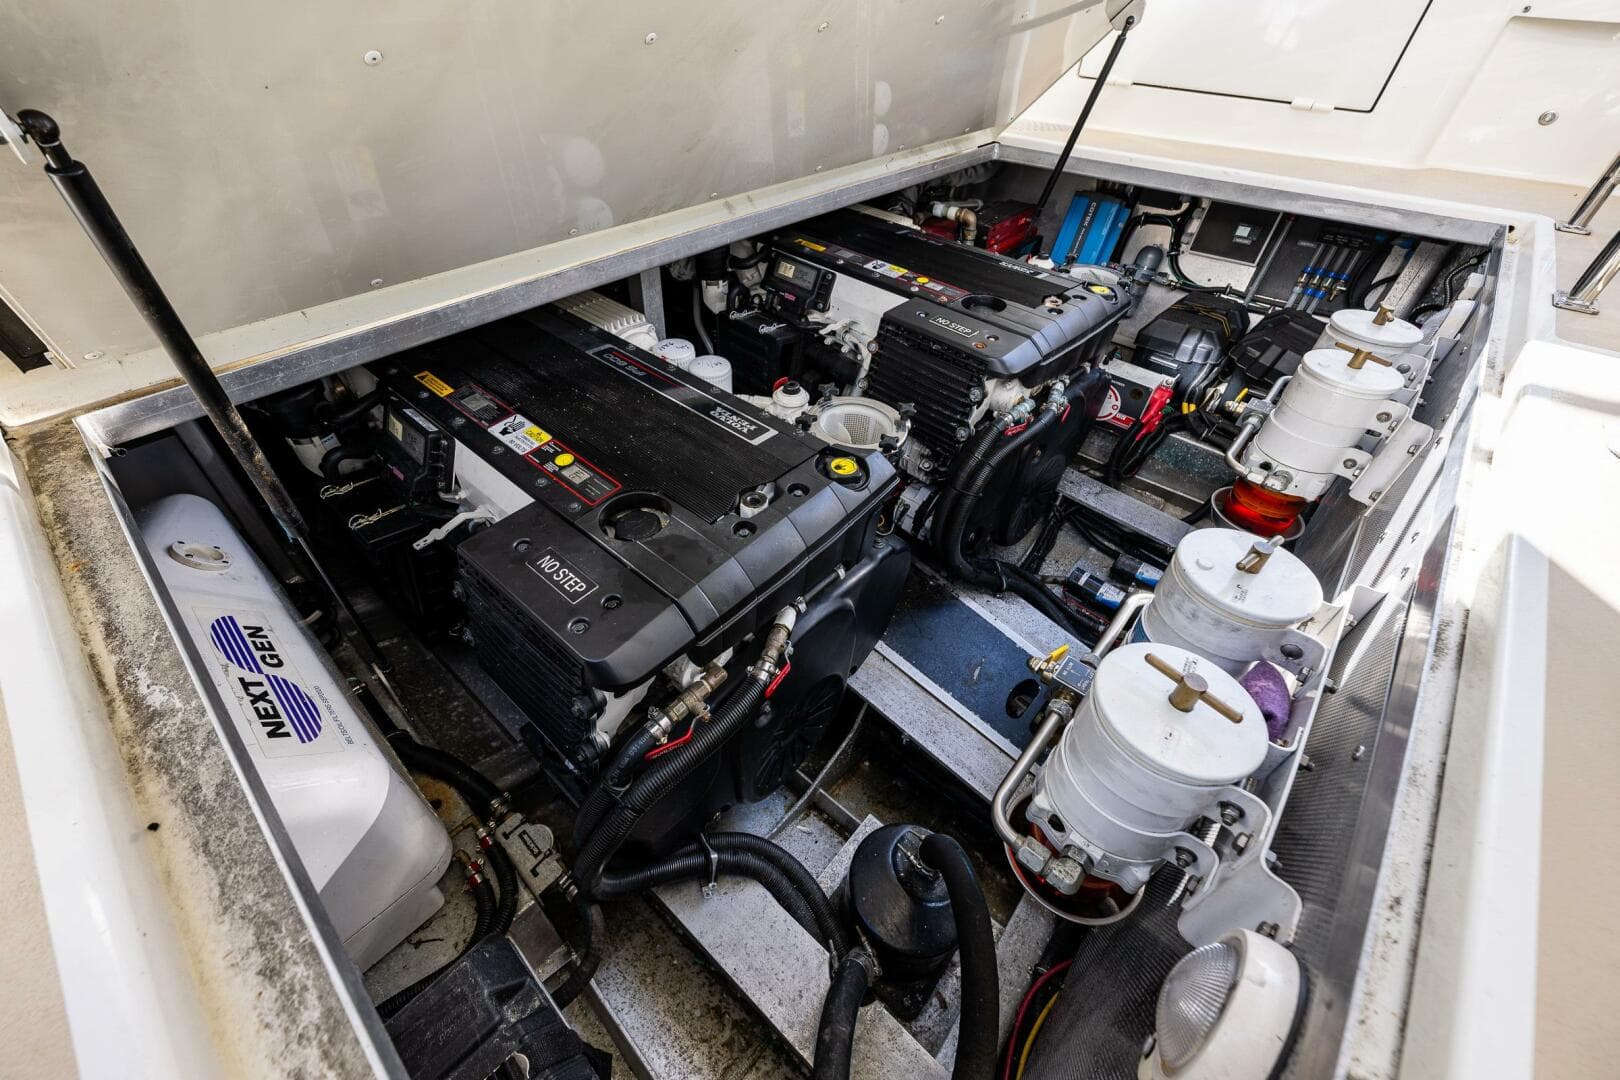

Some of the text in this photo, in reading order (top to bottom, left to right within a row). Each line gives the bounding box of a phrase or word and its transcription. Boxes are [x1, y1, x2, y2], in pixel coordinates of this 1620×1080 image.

[935, 315, 972, 336] NO STEP
[709, 410, 748, 434] VOLVO
[716, 406, 759, 431] PENTA
[536, 554, 587, 593] NO STEP
[238, 625, 292, 739] NEXT GEN
